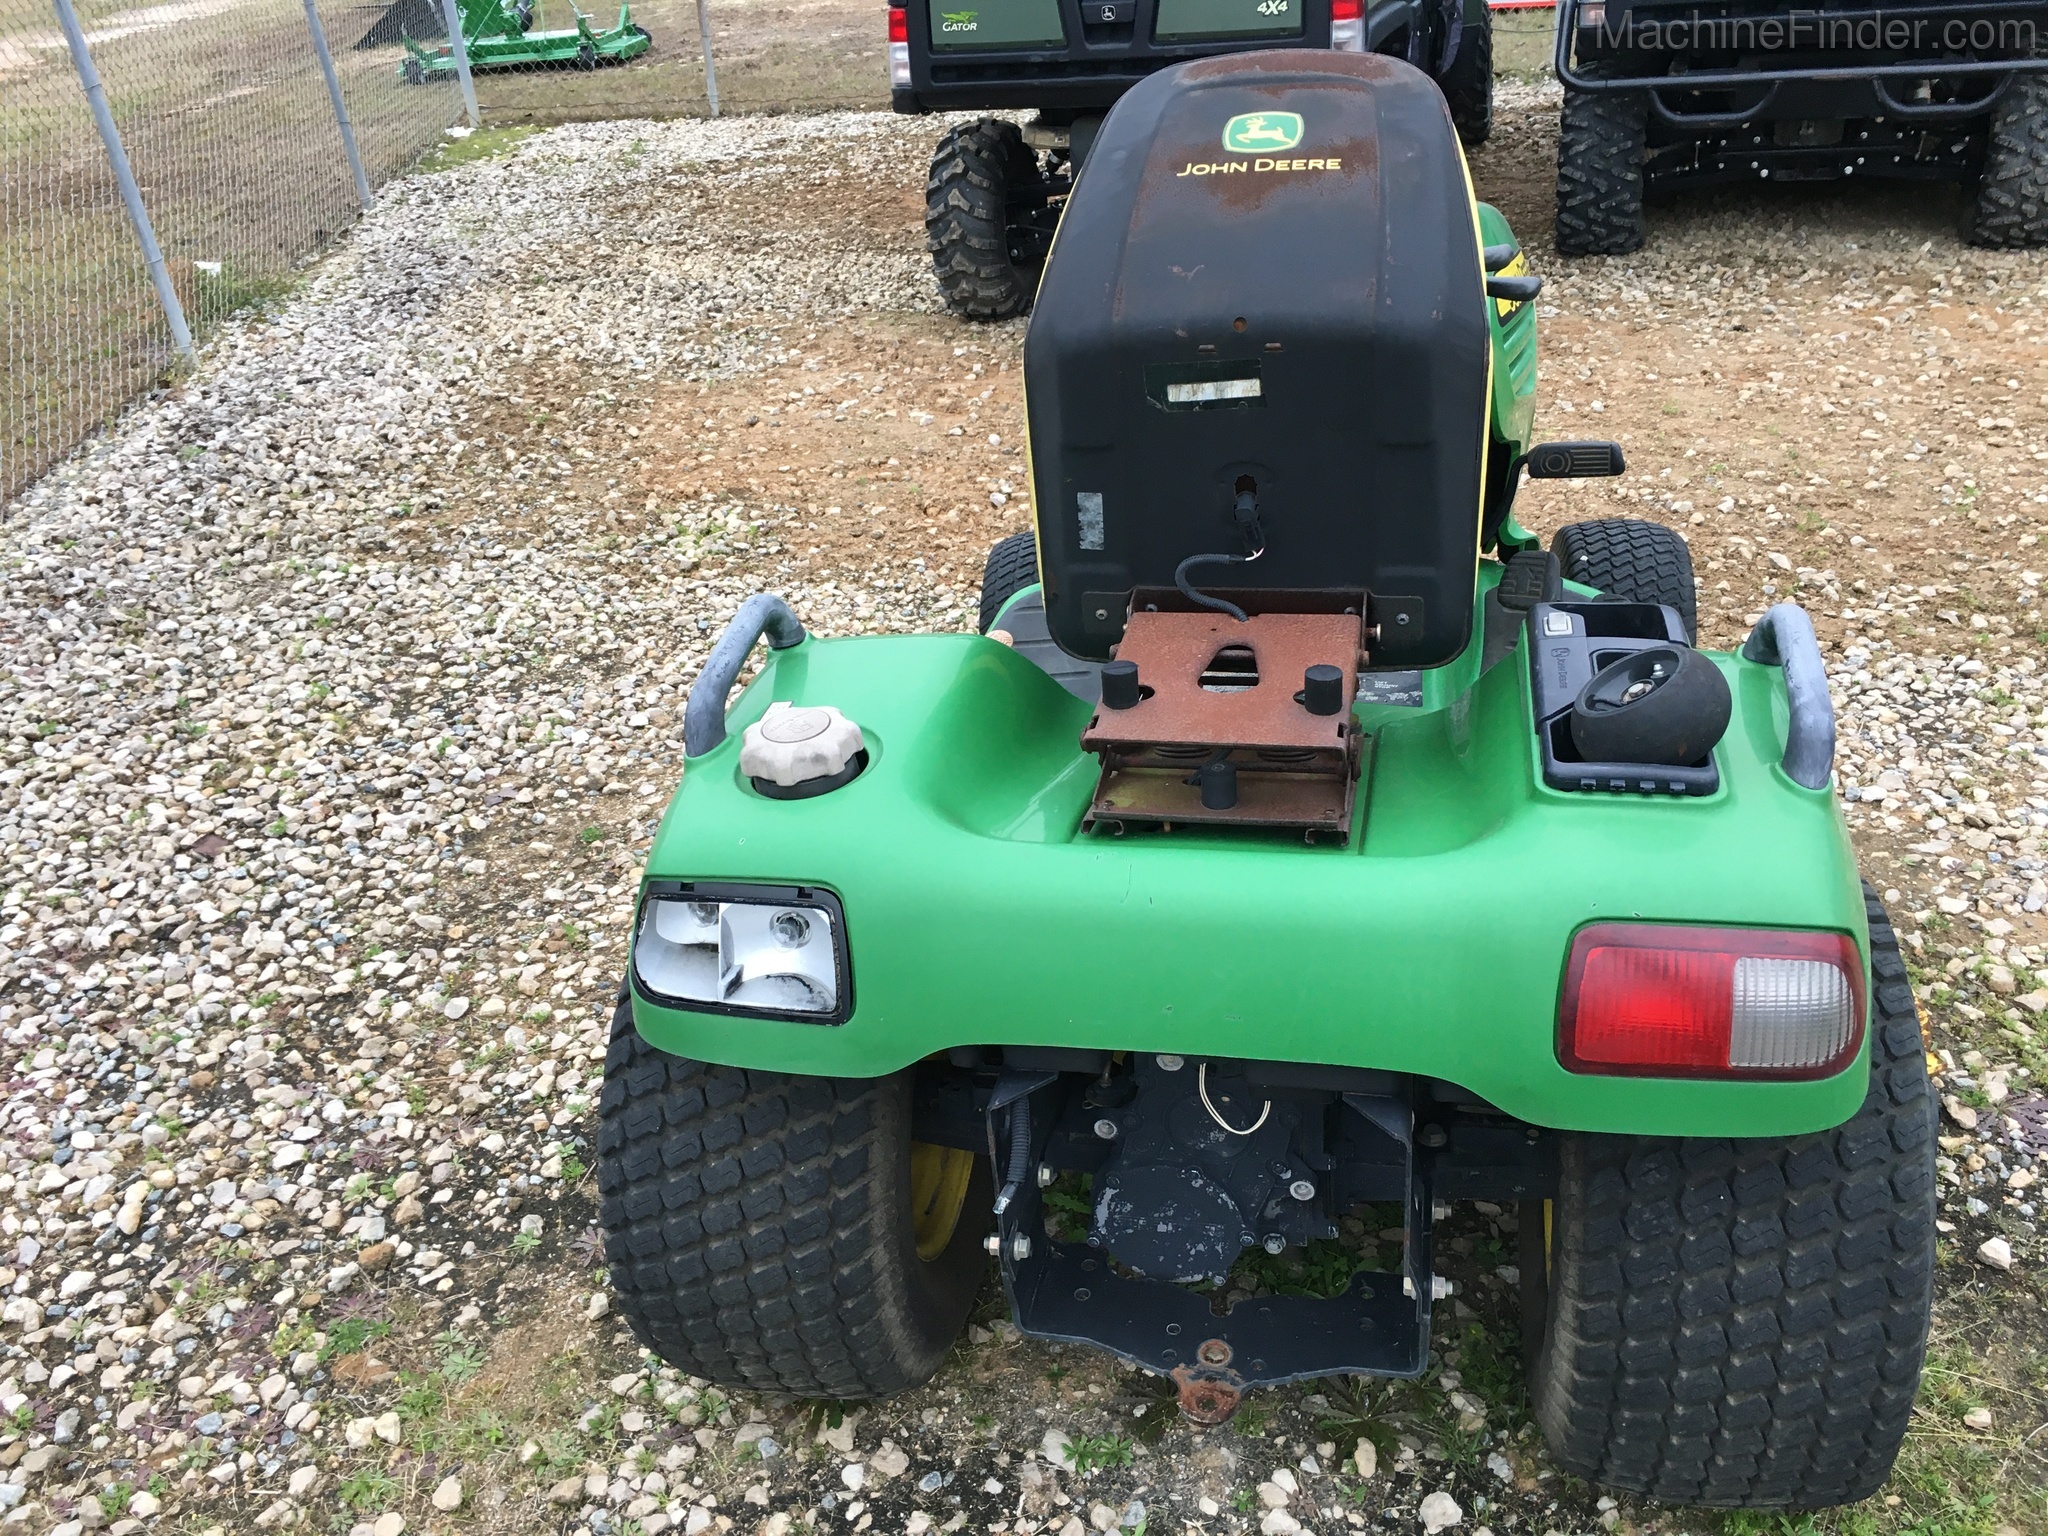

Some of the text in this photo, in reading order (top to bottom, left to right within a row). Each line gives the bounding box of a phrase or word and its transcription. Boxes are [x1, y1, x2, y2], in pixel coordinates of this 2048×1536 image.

[942, 22, 978, 32] GATOR
[1176, 158, 1342, 177] JOHN DEERE
